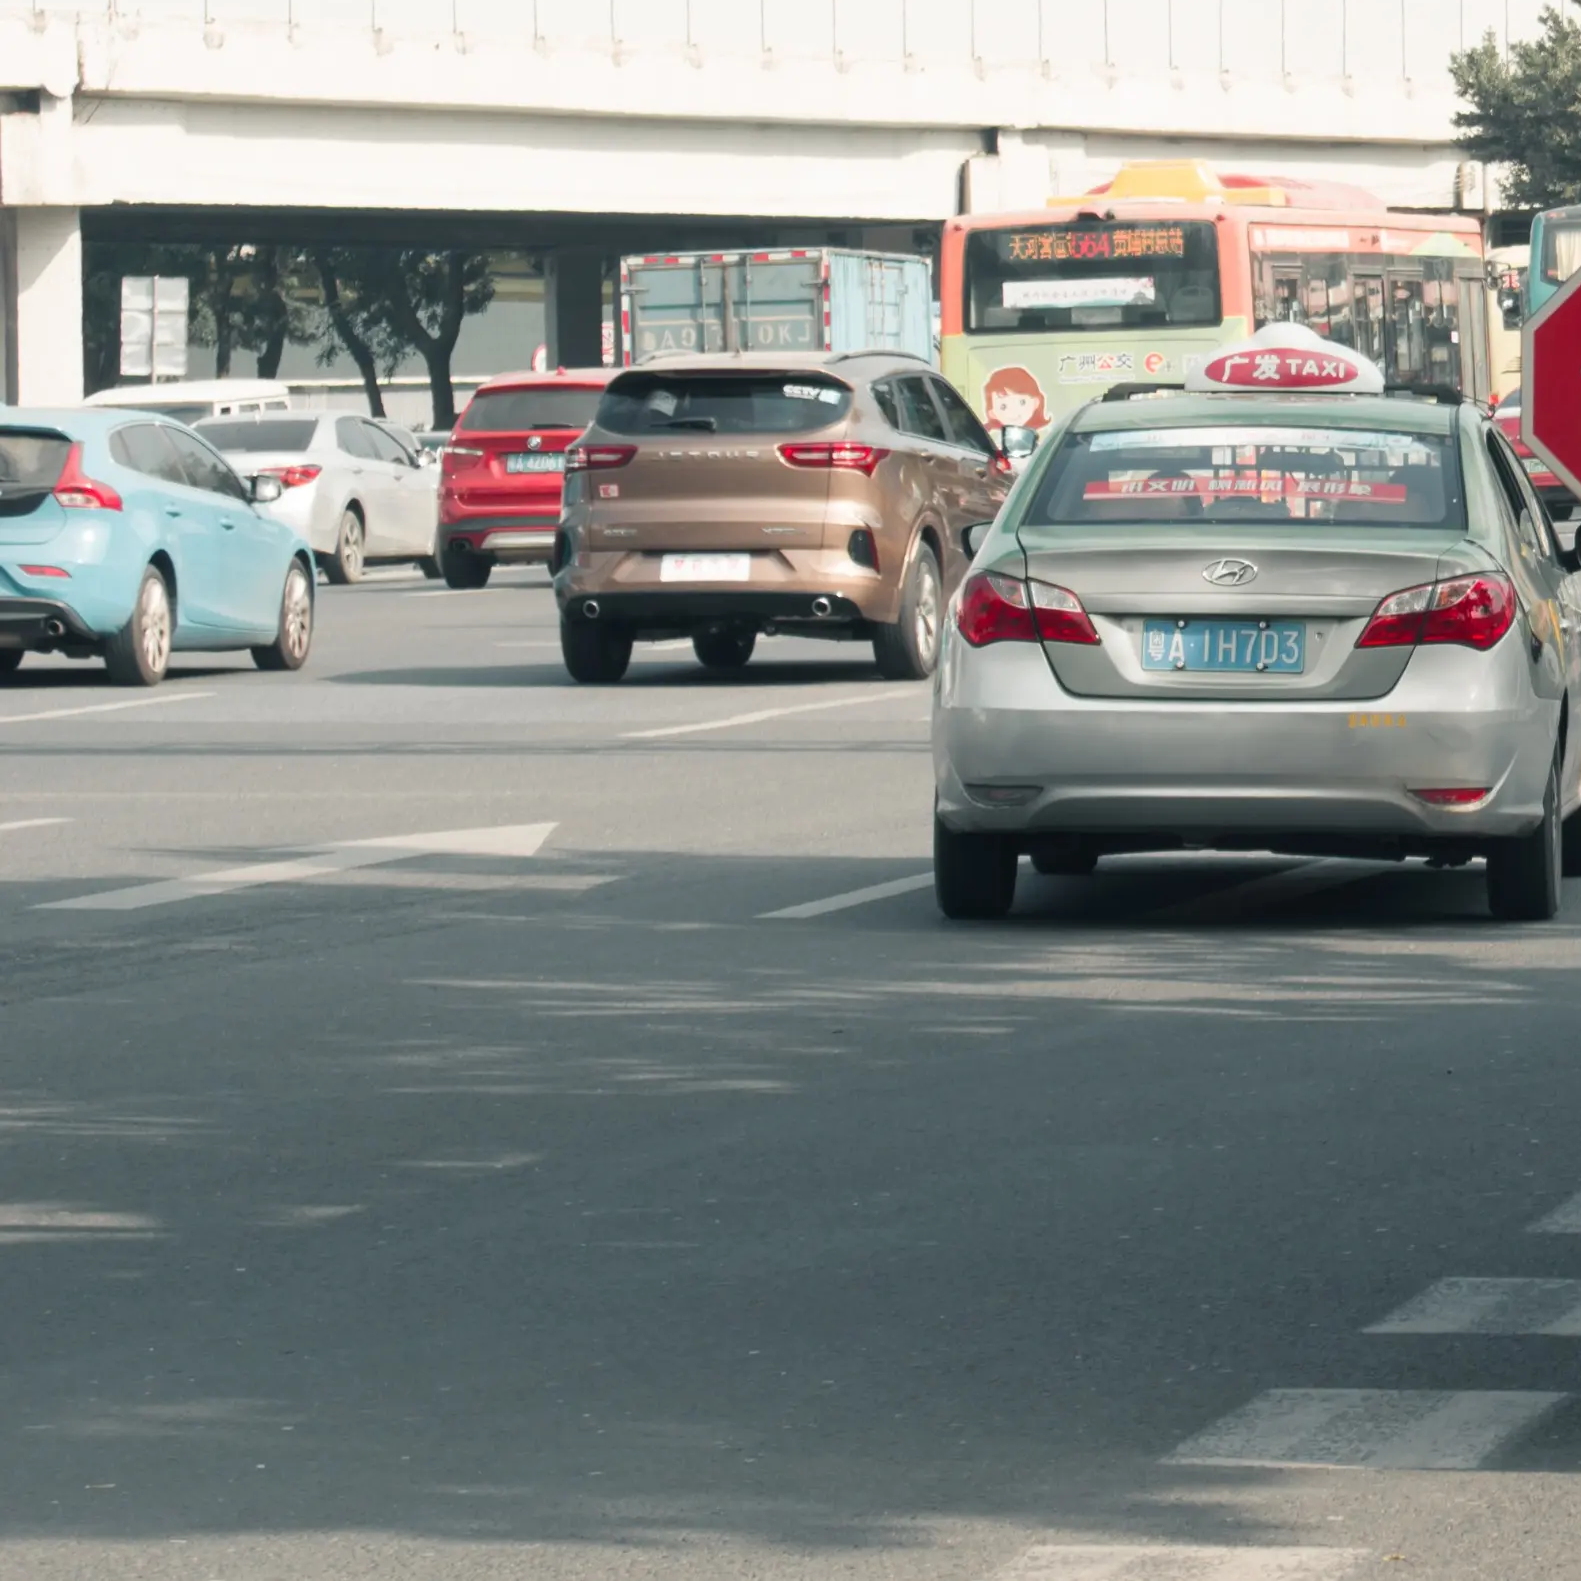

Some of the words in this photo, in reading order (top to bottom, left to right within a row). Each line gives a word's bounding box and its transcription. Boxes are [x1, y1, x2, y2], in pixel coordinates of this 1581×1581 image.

[1059, 353, 1134, 373] 广州公交
[1222, 354, 1281, 383] 广发
[1286, 358, 1346, 379] TAXI
